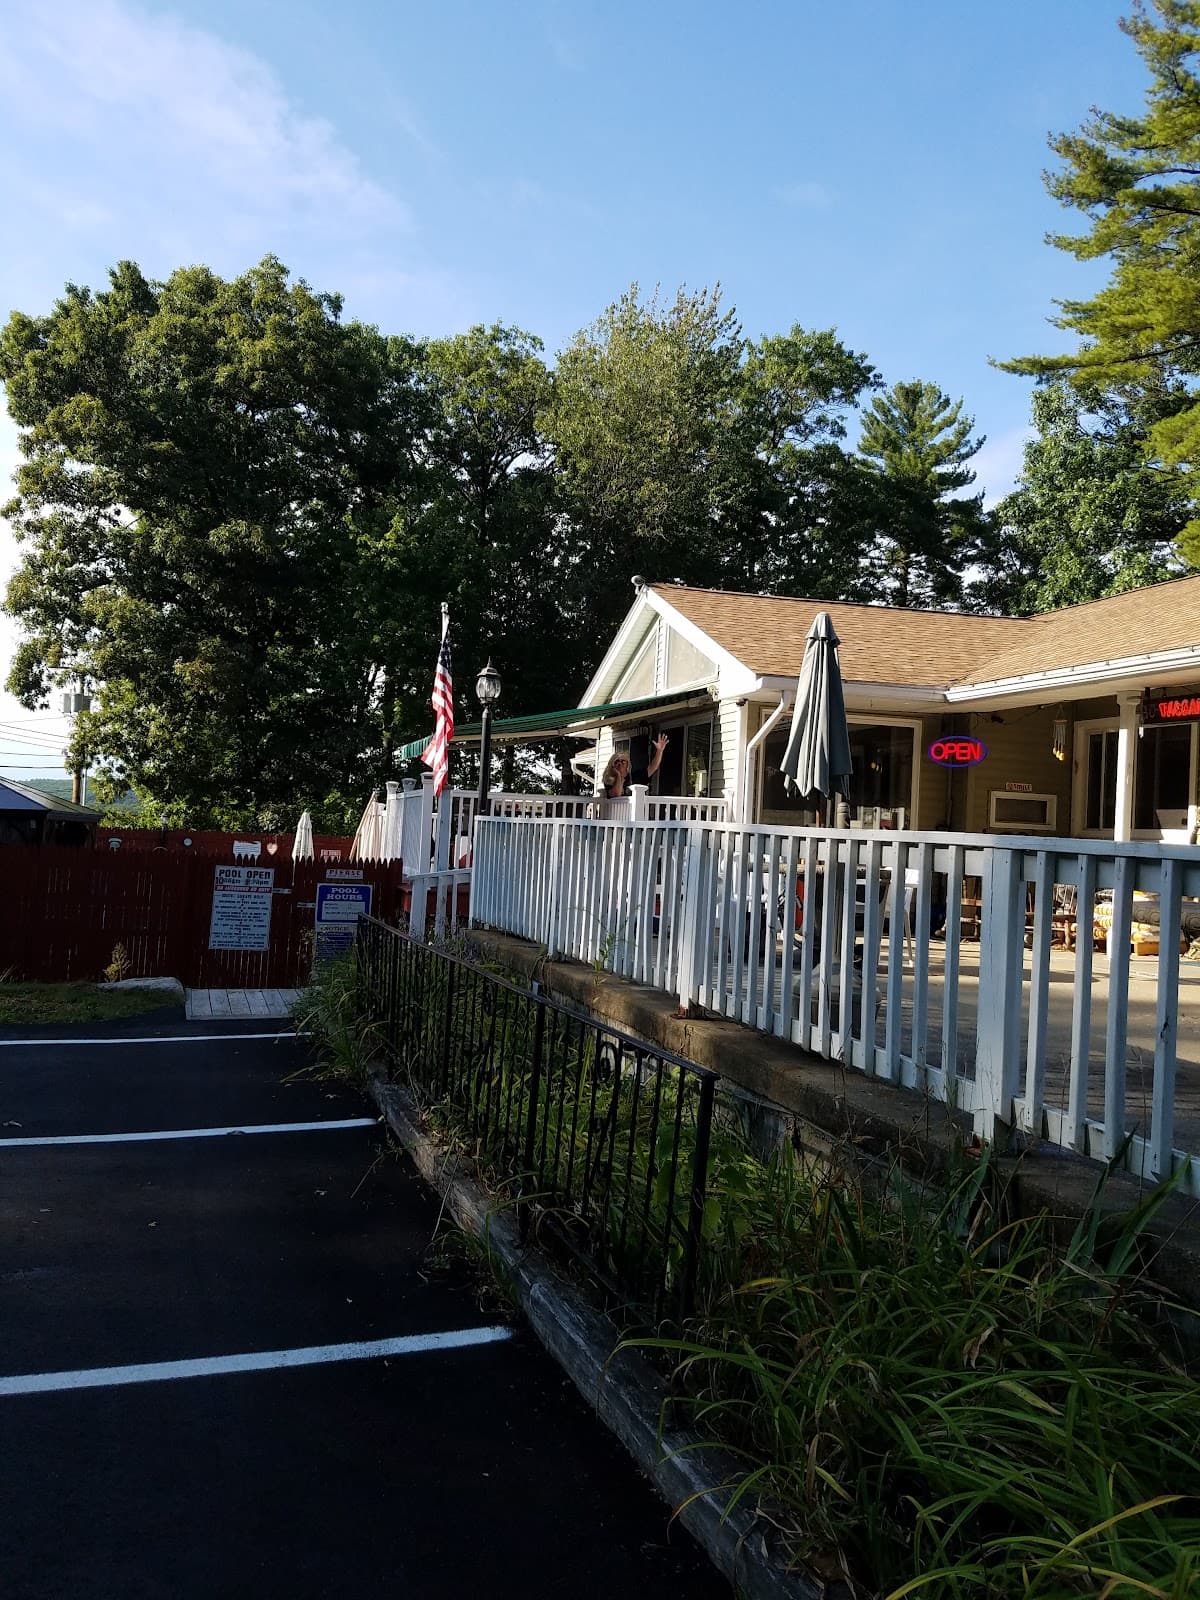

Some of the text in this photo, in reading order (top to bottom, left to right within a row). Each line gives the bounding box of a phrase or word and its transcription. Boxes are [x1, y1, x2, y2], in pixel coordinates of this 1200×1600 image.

[930, 742, 981, 761] OPEN
[219, 869, 271, 879] POOL OPEN
[326, 893, 363, 901] HOURS
